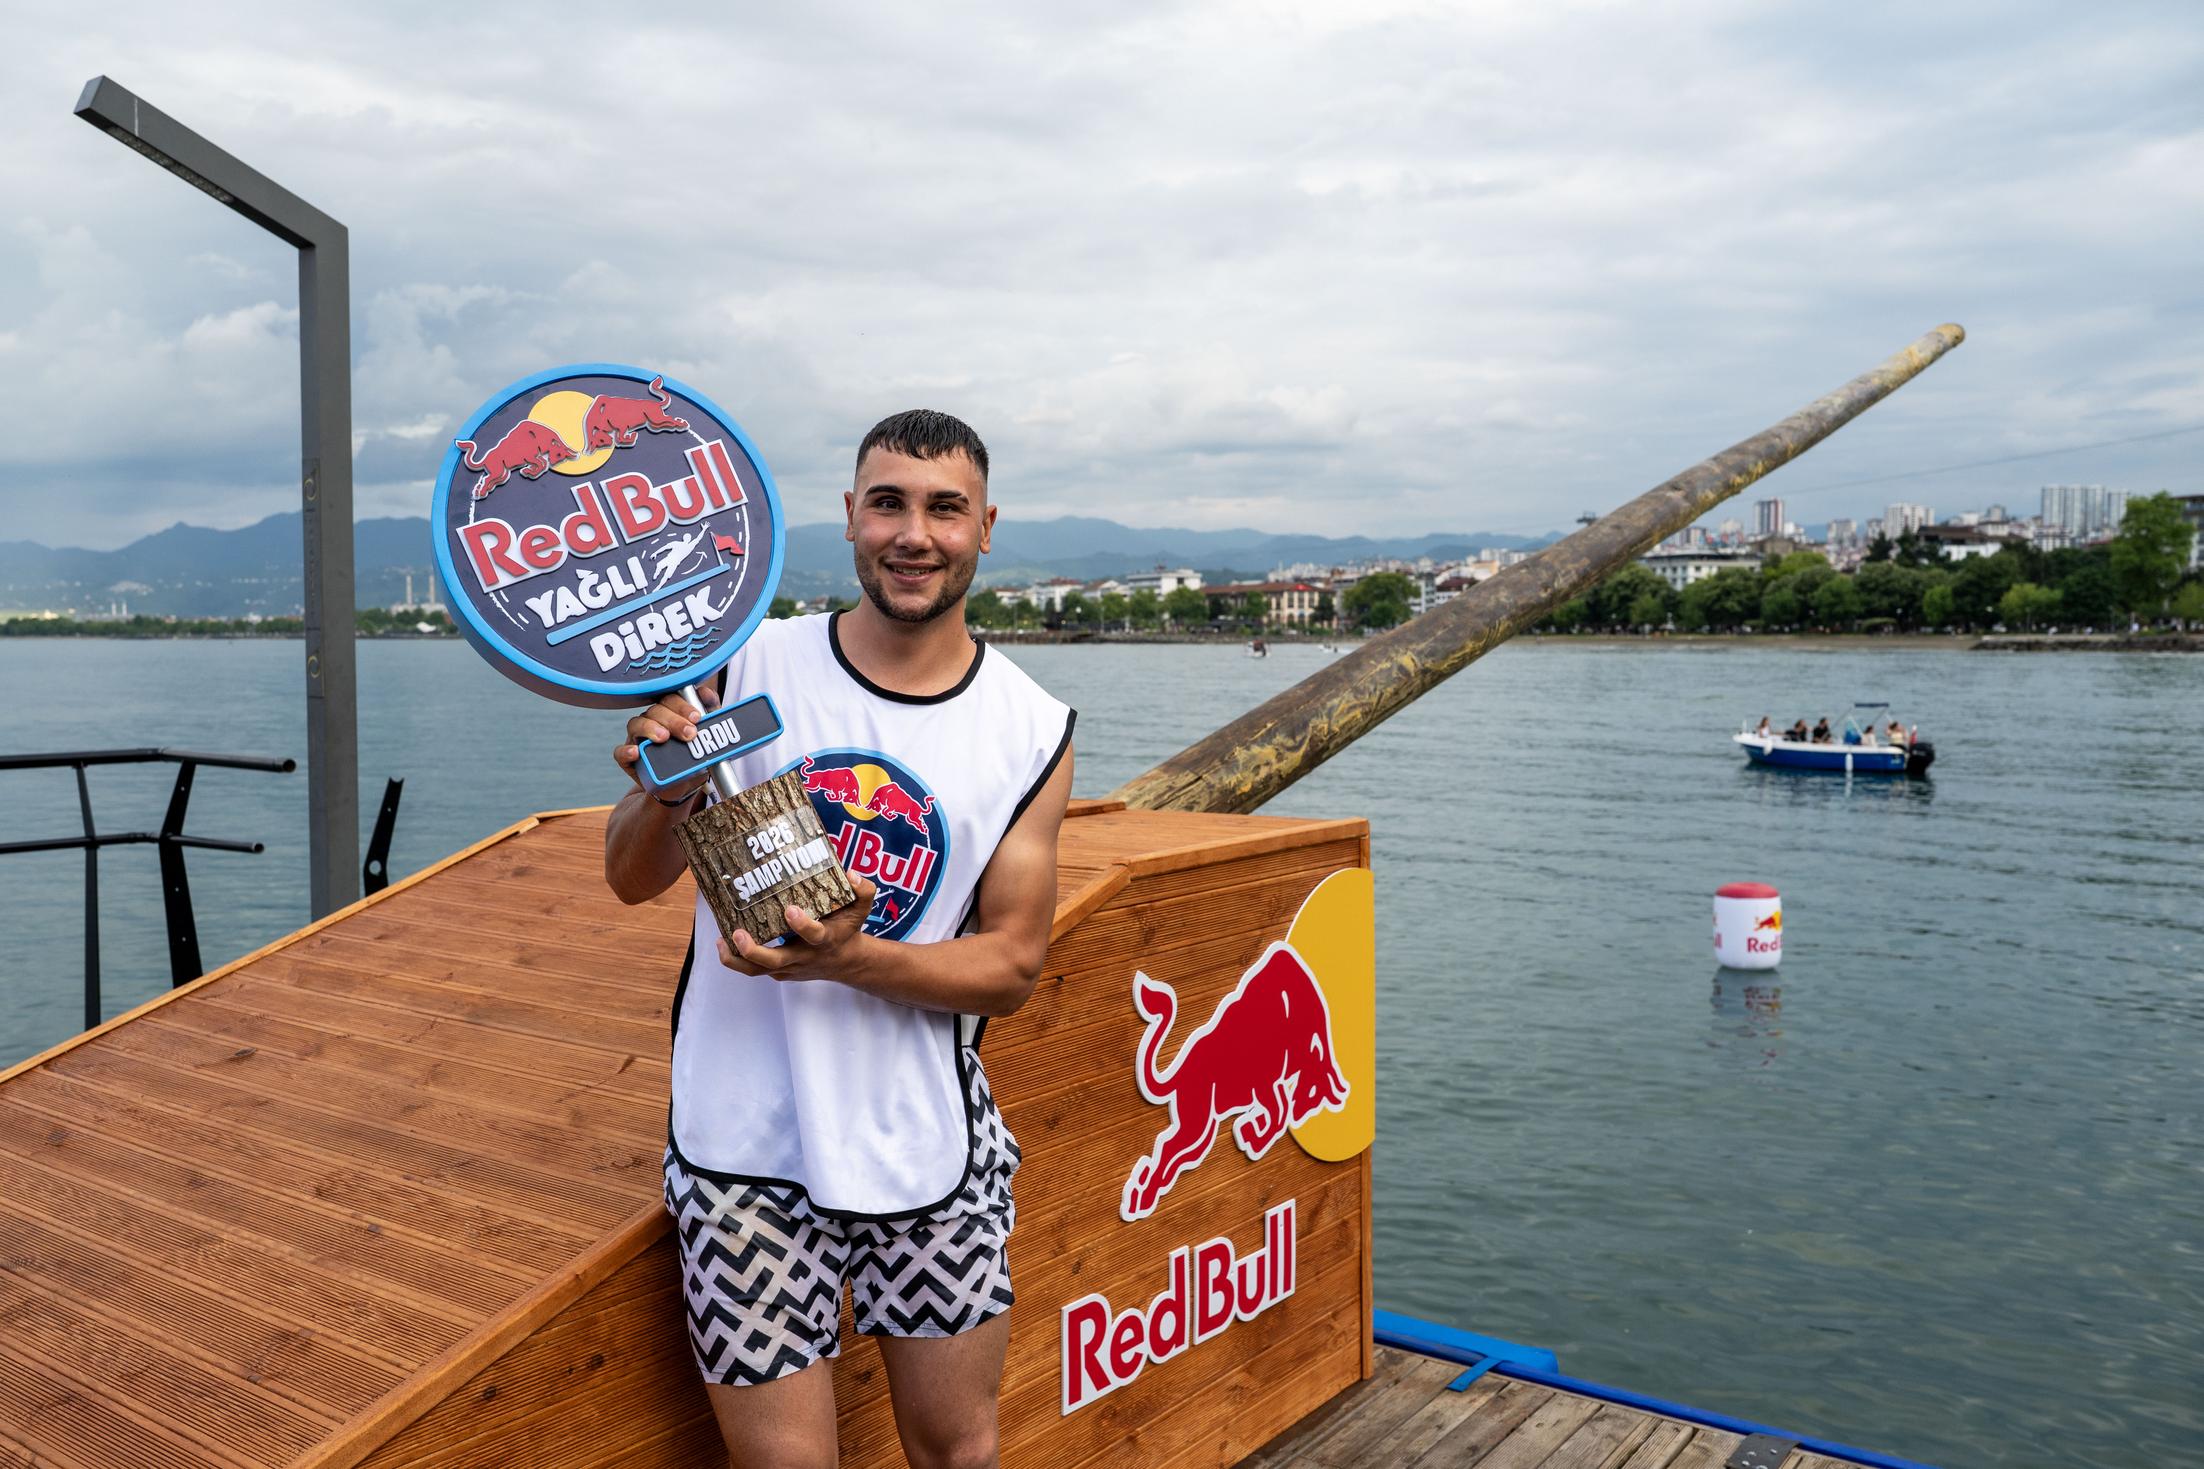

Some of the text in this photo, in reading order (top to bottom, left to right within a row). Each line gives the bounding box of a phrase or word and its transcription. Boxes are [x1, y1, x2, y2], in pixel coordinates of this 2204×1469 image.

[459, 441, 747, 590] Red Bull
[525, 556, 649, 629] YAĞLI
[747, 822, 795, 860] 2026
[850, 829, 937, 895] Bull
[1747, 935, 1779, 953] Red
[1066, 1205, 1294, 1408] Red Bull
